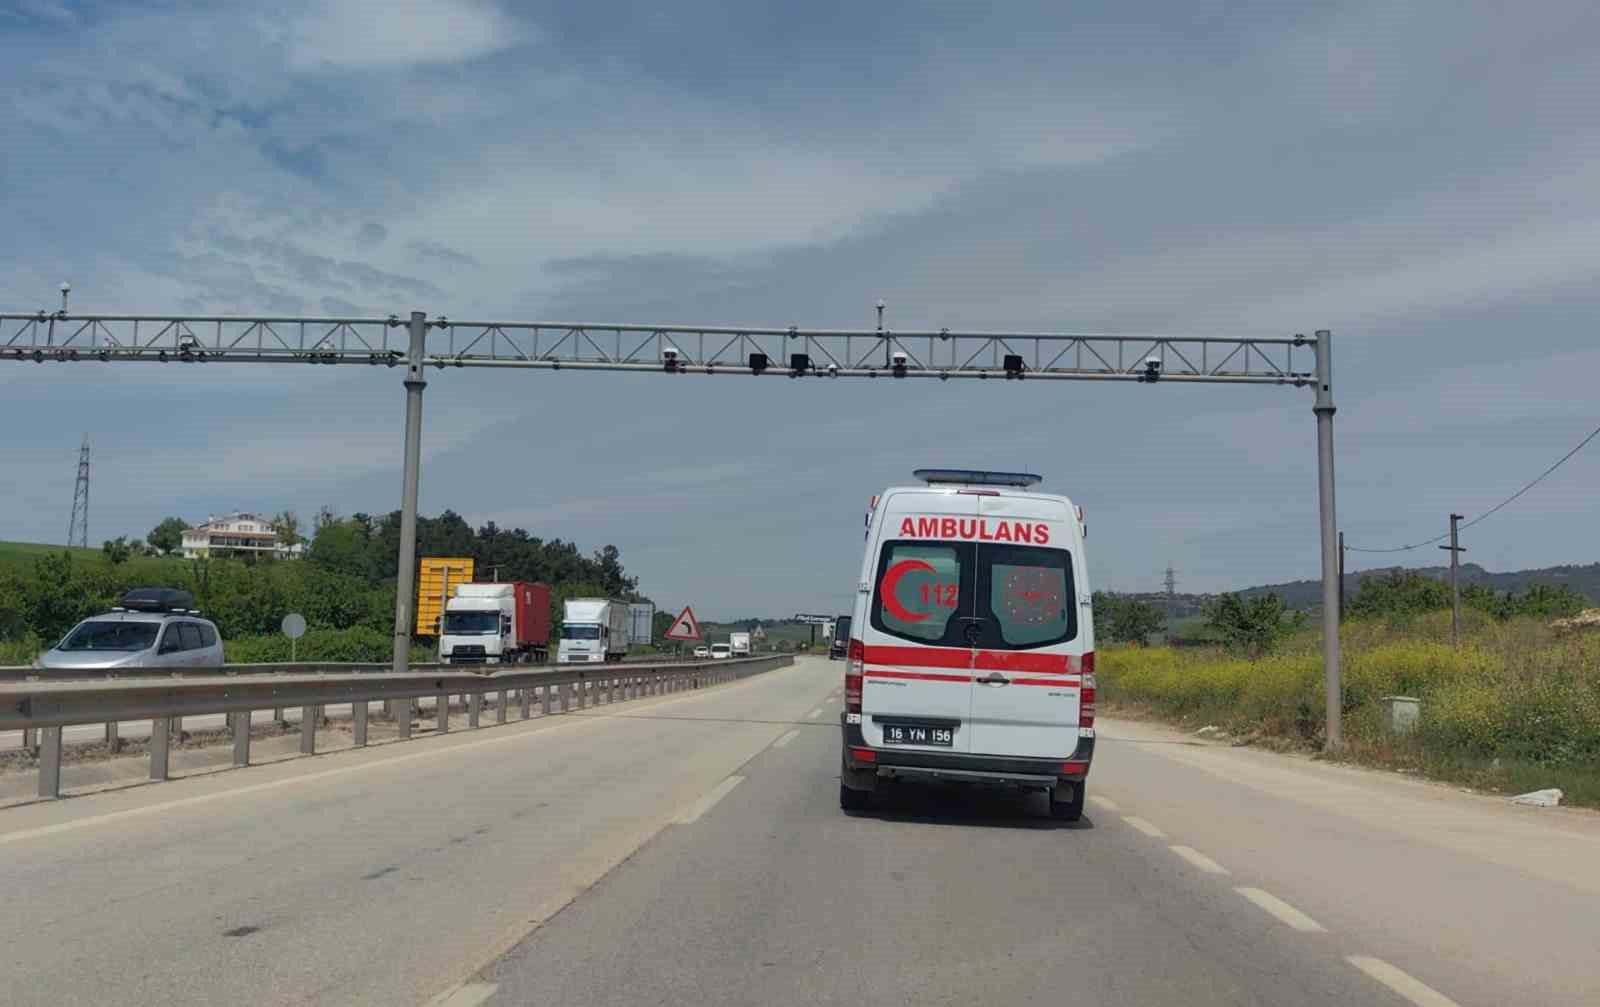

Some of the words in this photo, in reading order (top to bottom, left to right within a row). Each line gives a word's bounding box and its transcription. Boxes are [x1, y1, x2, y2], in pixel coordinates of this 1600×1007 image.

[899, 516, 1049, 544] AMBULANS
[920, 582, 958, 608] 112
[890, 727, 903, 739] 16
[909, 728, 926, 740] YN
[932, 729, 951, 742] 156
